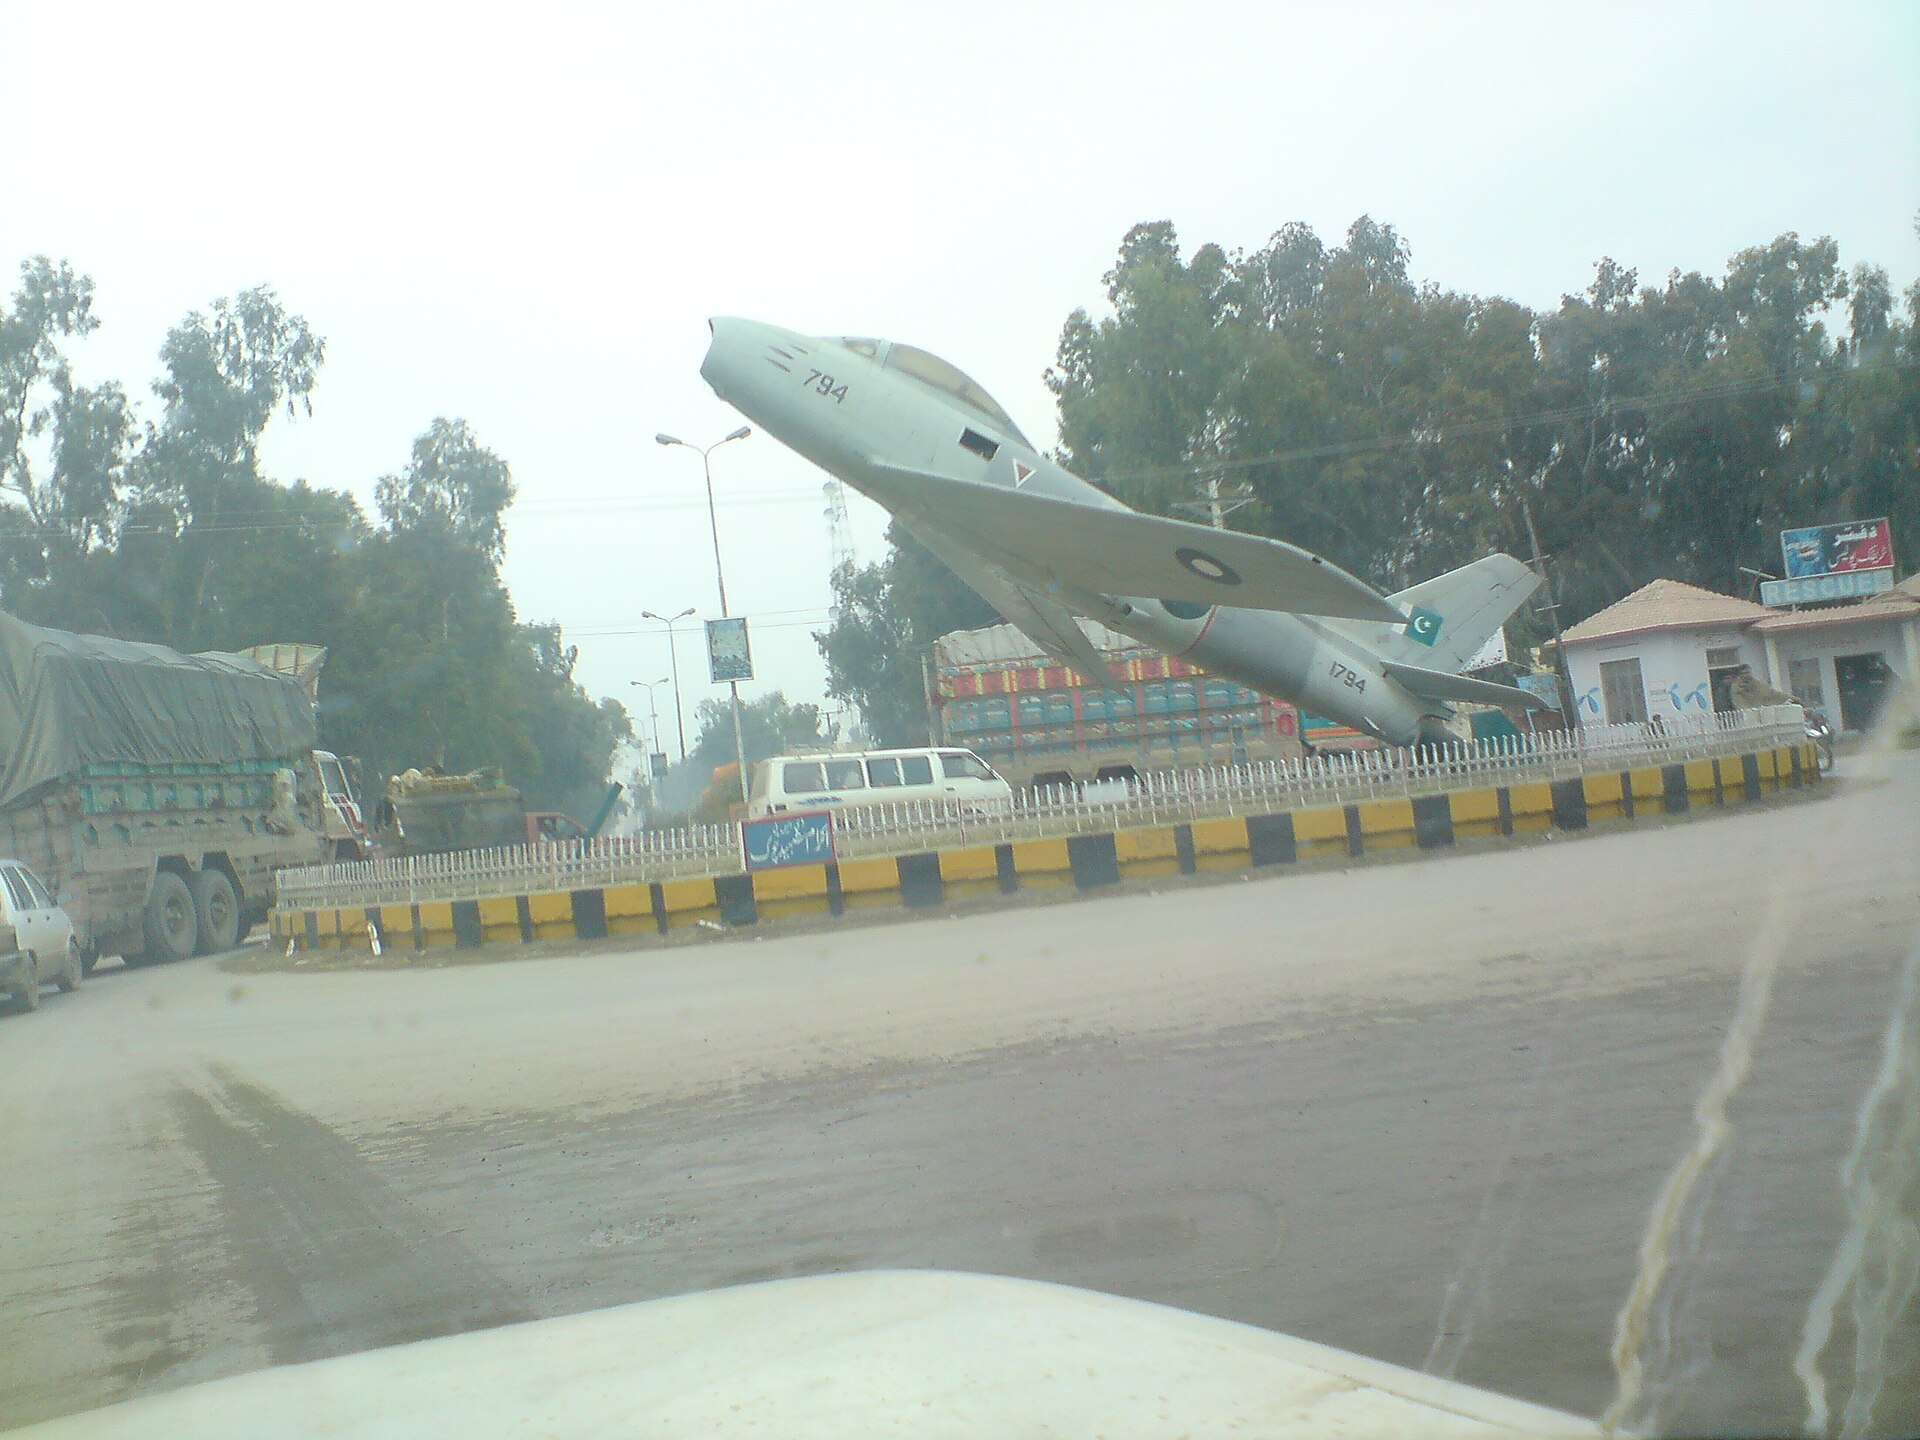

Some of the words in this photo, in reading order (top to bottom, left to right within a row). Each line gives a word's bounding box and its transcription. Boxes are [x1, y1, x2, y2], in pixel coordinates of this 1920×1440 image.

[803, 368, 849, 404] 794
[1765, 572, 1874, 605] RESCUE
[1329, 661, 1367, 695] 1794
